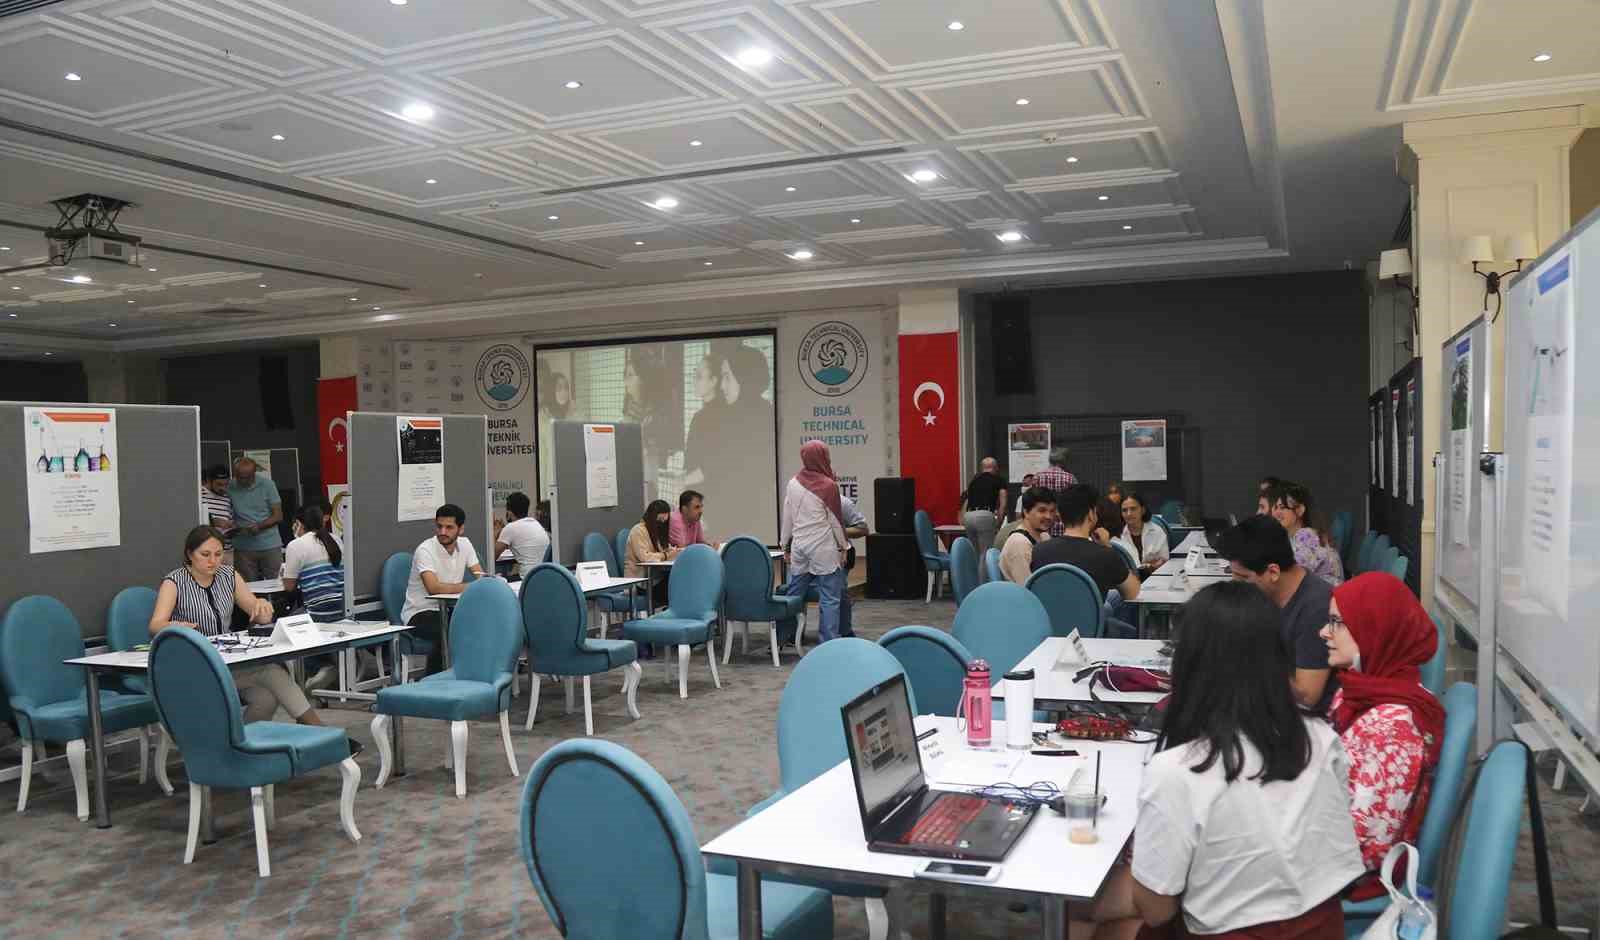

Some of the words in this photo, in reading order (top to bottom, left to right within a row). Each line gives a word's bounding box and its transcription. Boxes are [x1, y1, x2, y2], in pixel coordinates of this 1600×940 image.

[813, 406, 851, 417] BURSA
[488, 418, 519, 430] BURSA
[802, 420, 865, 432] TECHNICAL
[488, 430, 522, 442] TEKNİK
